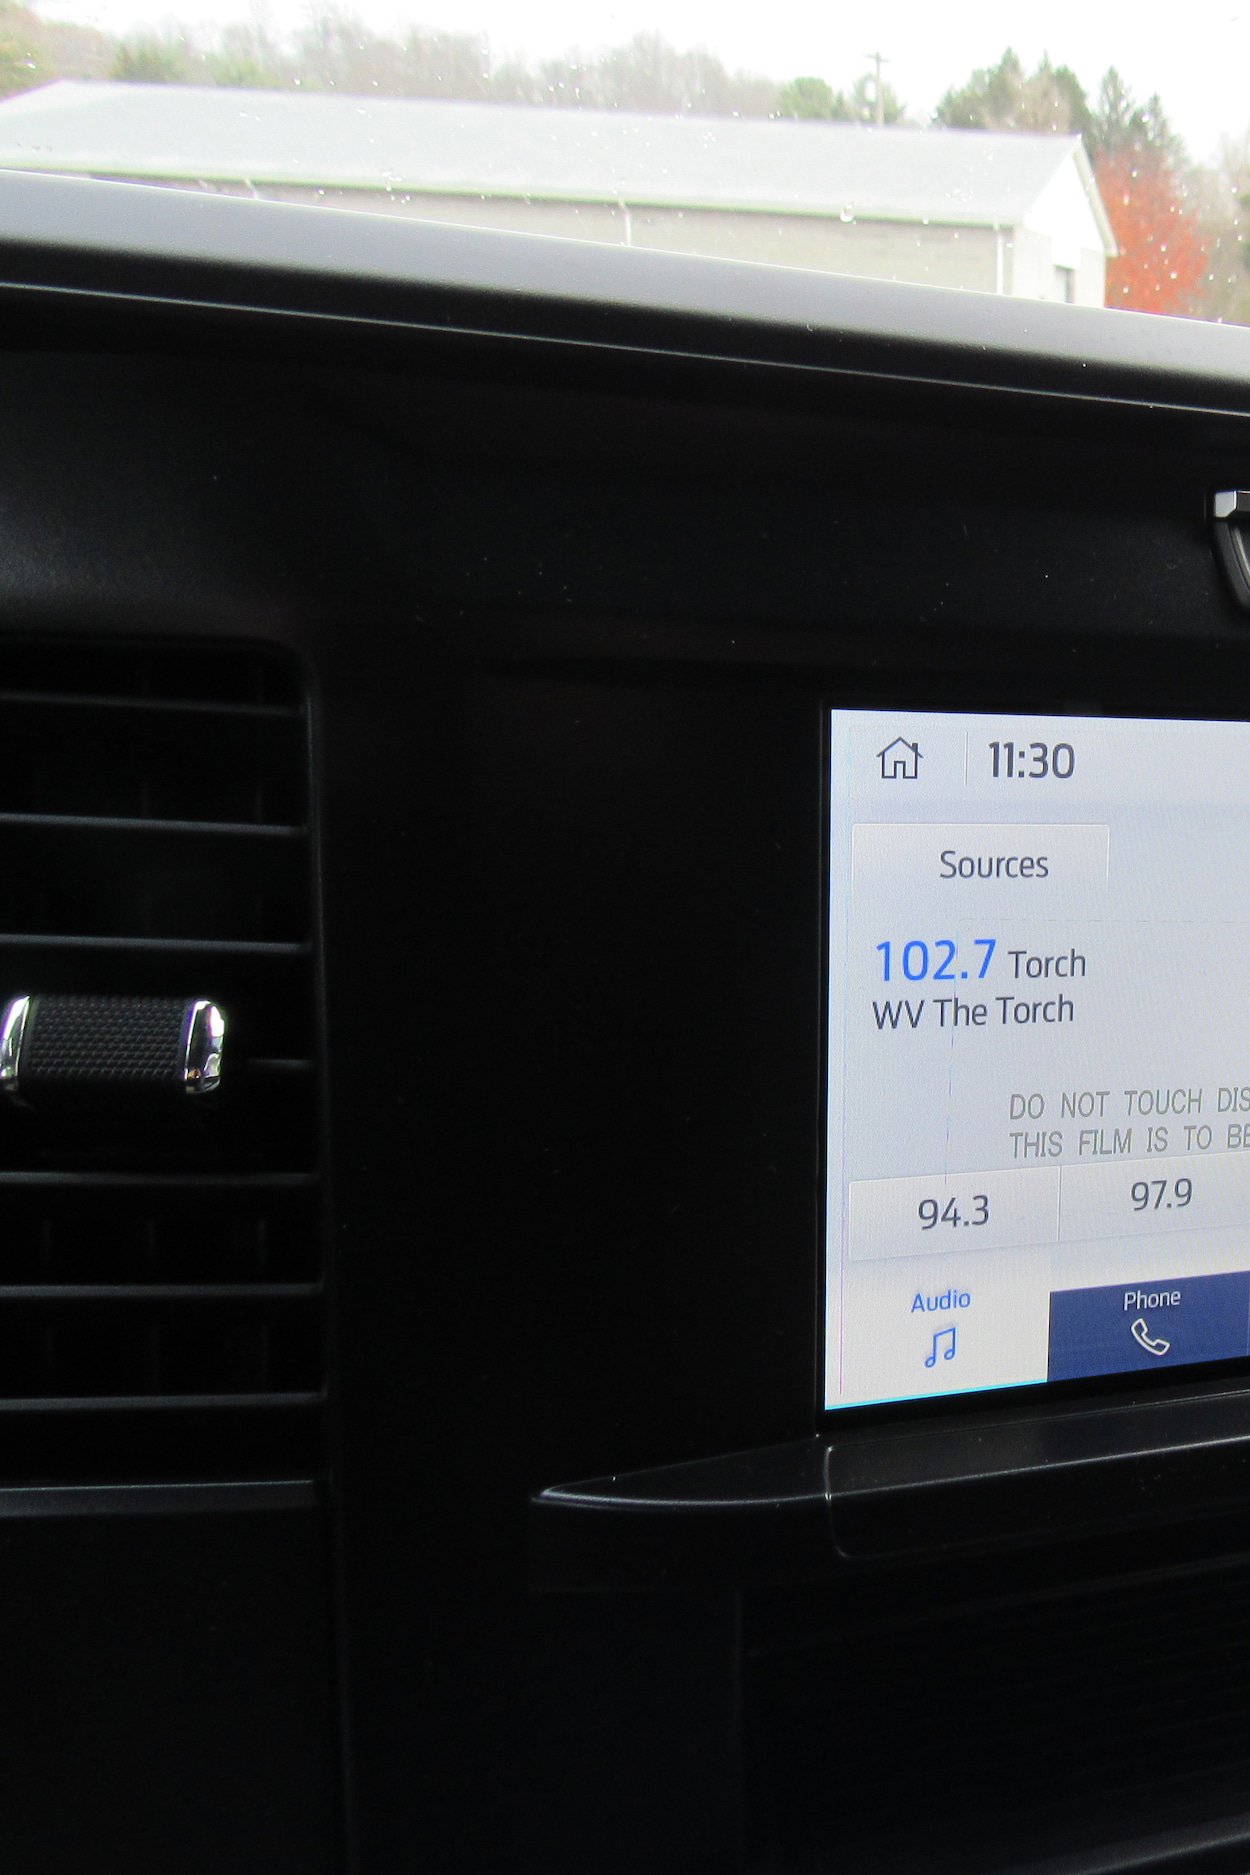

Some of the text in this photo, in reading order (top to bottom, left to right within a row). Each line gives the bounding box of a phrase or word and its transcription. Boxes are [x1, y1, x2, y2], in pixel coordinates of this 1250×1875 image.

[988, 740, 1076, 779] 11:30
[939, 850, 1049, 880] Sources
[876, 938, 1087, 981] 102.7 Torch
[872, 994, 1075, 1030] WV The Torch
[1009, 1093, 1045, 1120] DO
[1061, 1091, 1110, 1119] NOT
[1124, 1088, 1201, 1116] TOUCH
[1009, 1131, 1063, 1160] THIS
[1079, 1128, 1132, 1156] FILM
[1146, 1126, 1168, 1153] IS
[1184, 1124, 1212, 1151] TO
[1130, 1177, 1194, 1211] 97.9
[917, 1194, 990, 1231] 94.3
[910, 1289, 971, 1313] Audio
[1123, 1289, 1181, 1311] Phone
